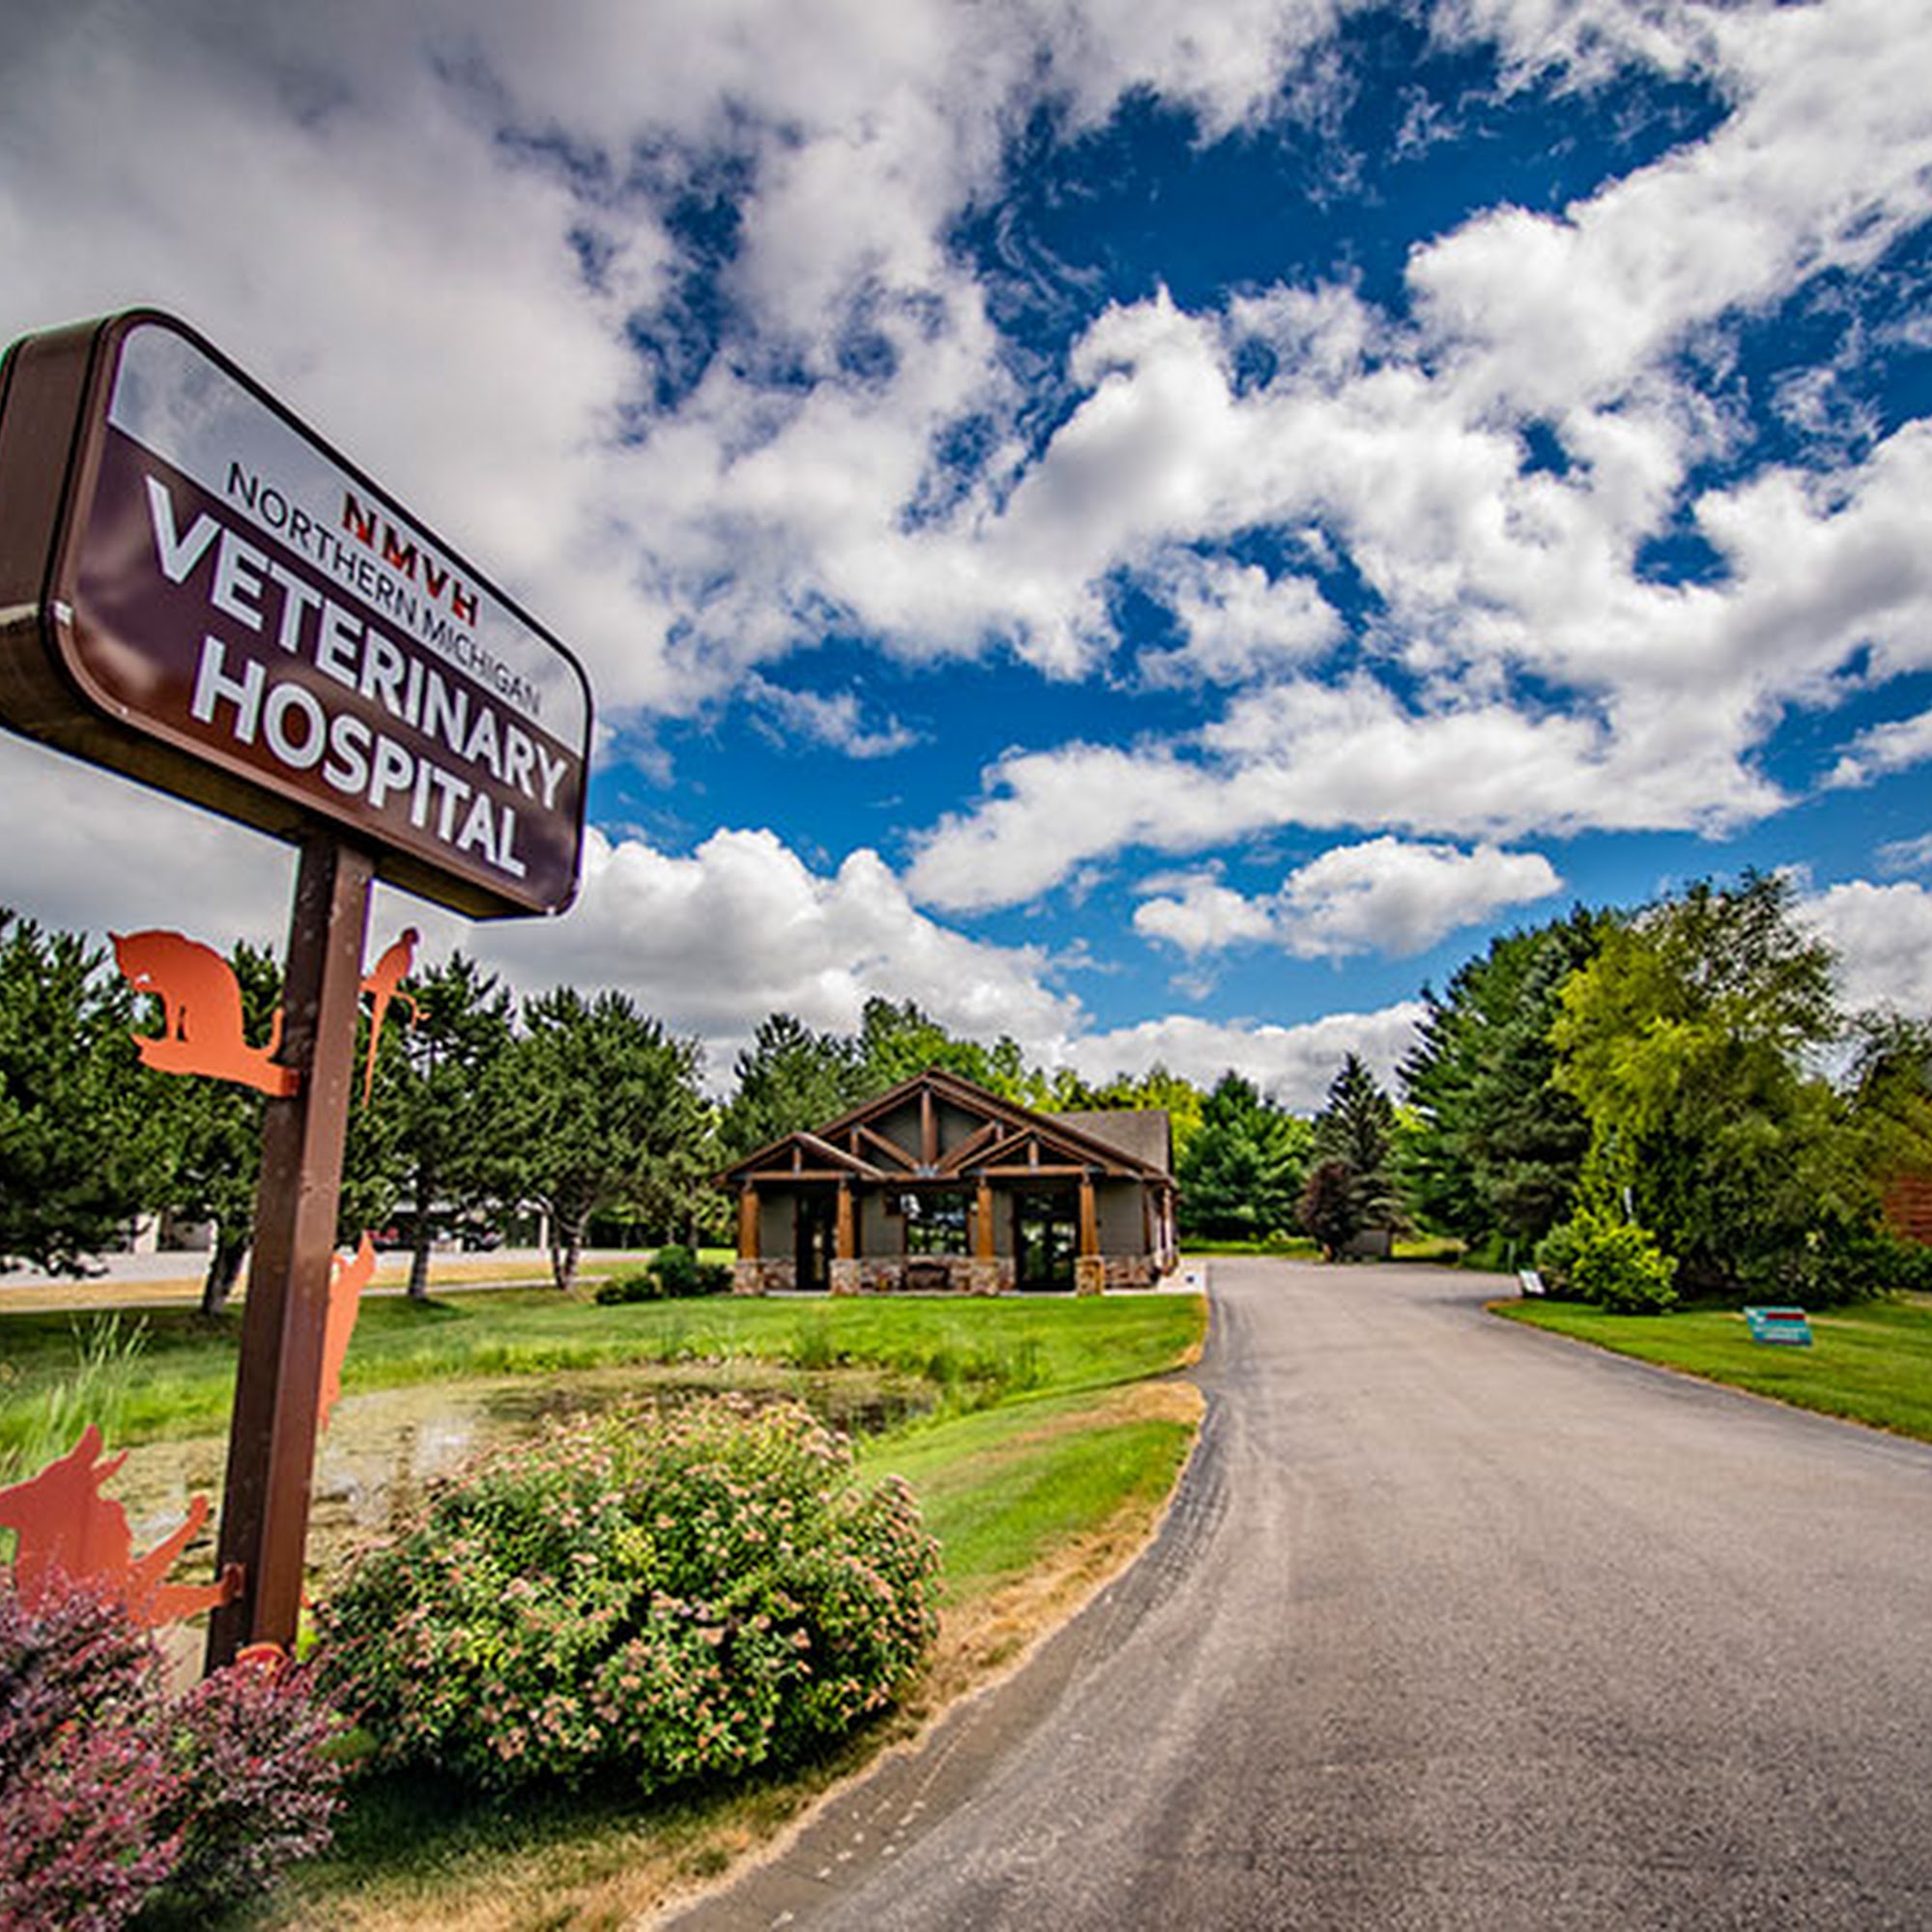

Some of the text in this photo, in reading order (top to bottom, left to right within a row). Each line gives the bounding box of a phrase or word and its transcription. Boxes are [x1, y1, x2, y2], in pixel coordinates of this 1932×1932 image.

[146, 474, 567, 810] VETERINARY
[227, 463, 542, 715] NORTHERN MICHIGAN
[342, 492, 480, 627] NMVH
[191, 636, 526, 878] HOSPITAL
